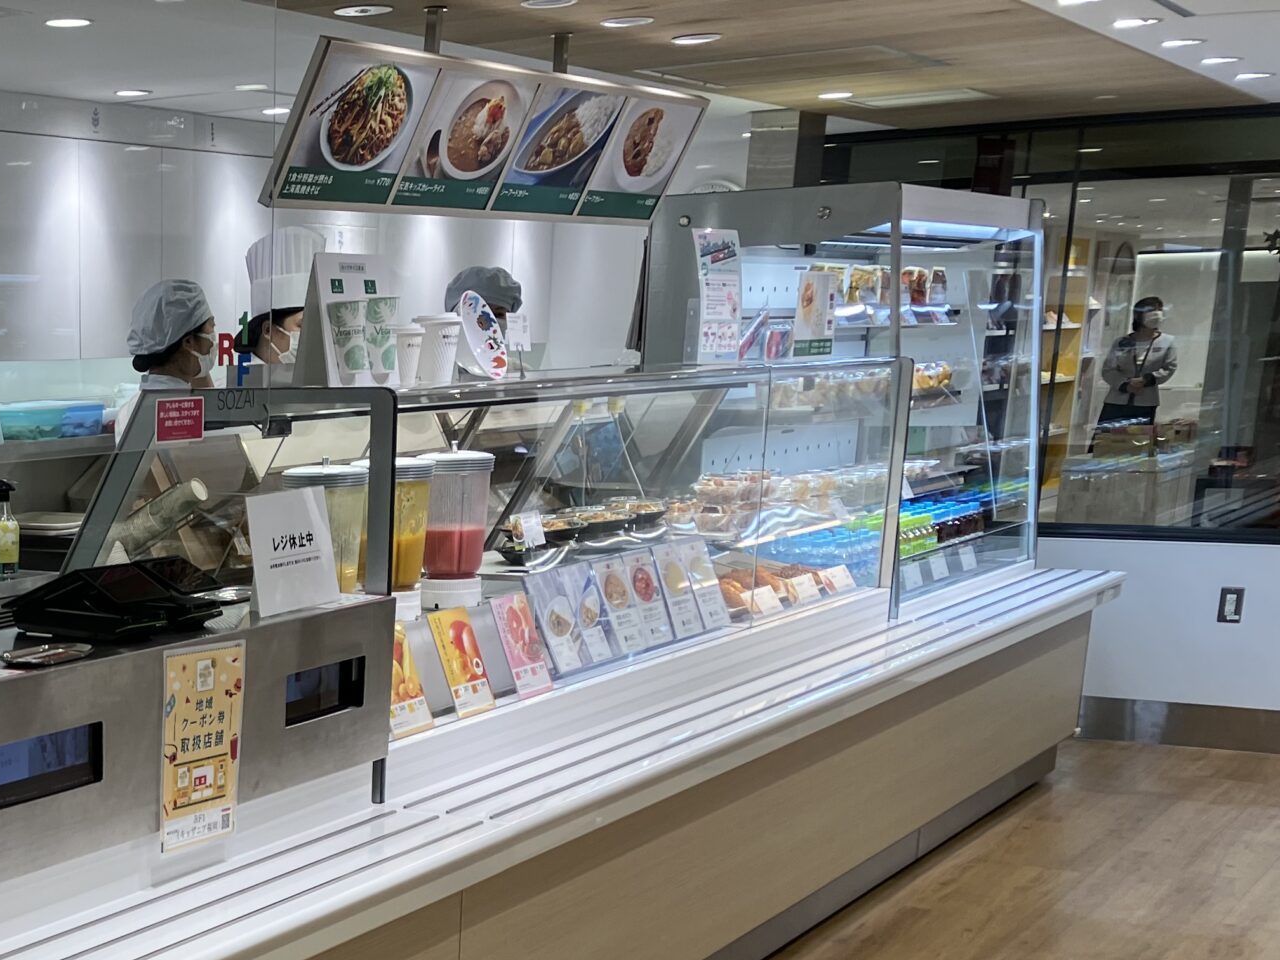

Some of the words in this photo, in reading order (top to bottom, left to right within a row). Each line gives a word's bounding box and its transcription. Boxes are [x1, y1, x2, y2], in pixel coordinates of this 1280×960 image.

[217, 389, 255, 411] SOZAI
[272, 531, 314, 552] レジ休止中
[195, 696, 213, 711] 地域
[182, 711, 225, 731] クーポン券
[180, 730, 224, 753] 取扱店舗
